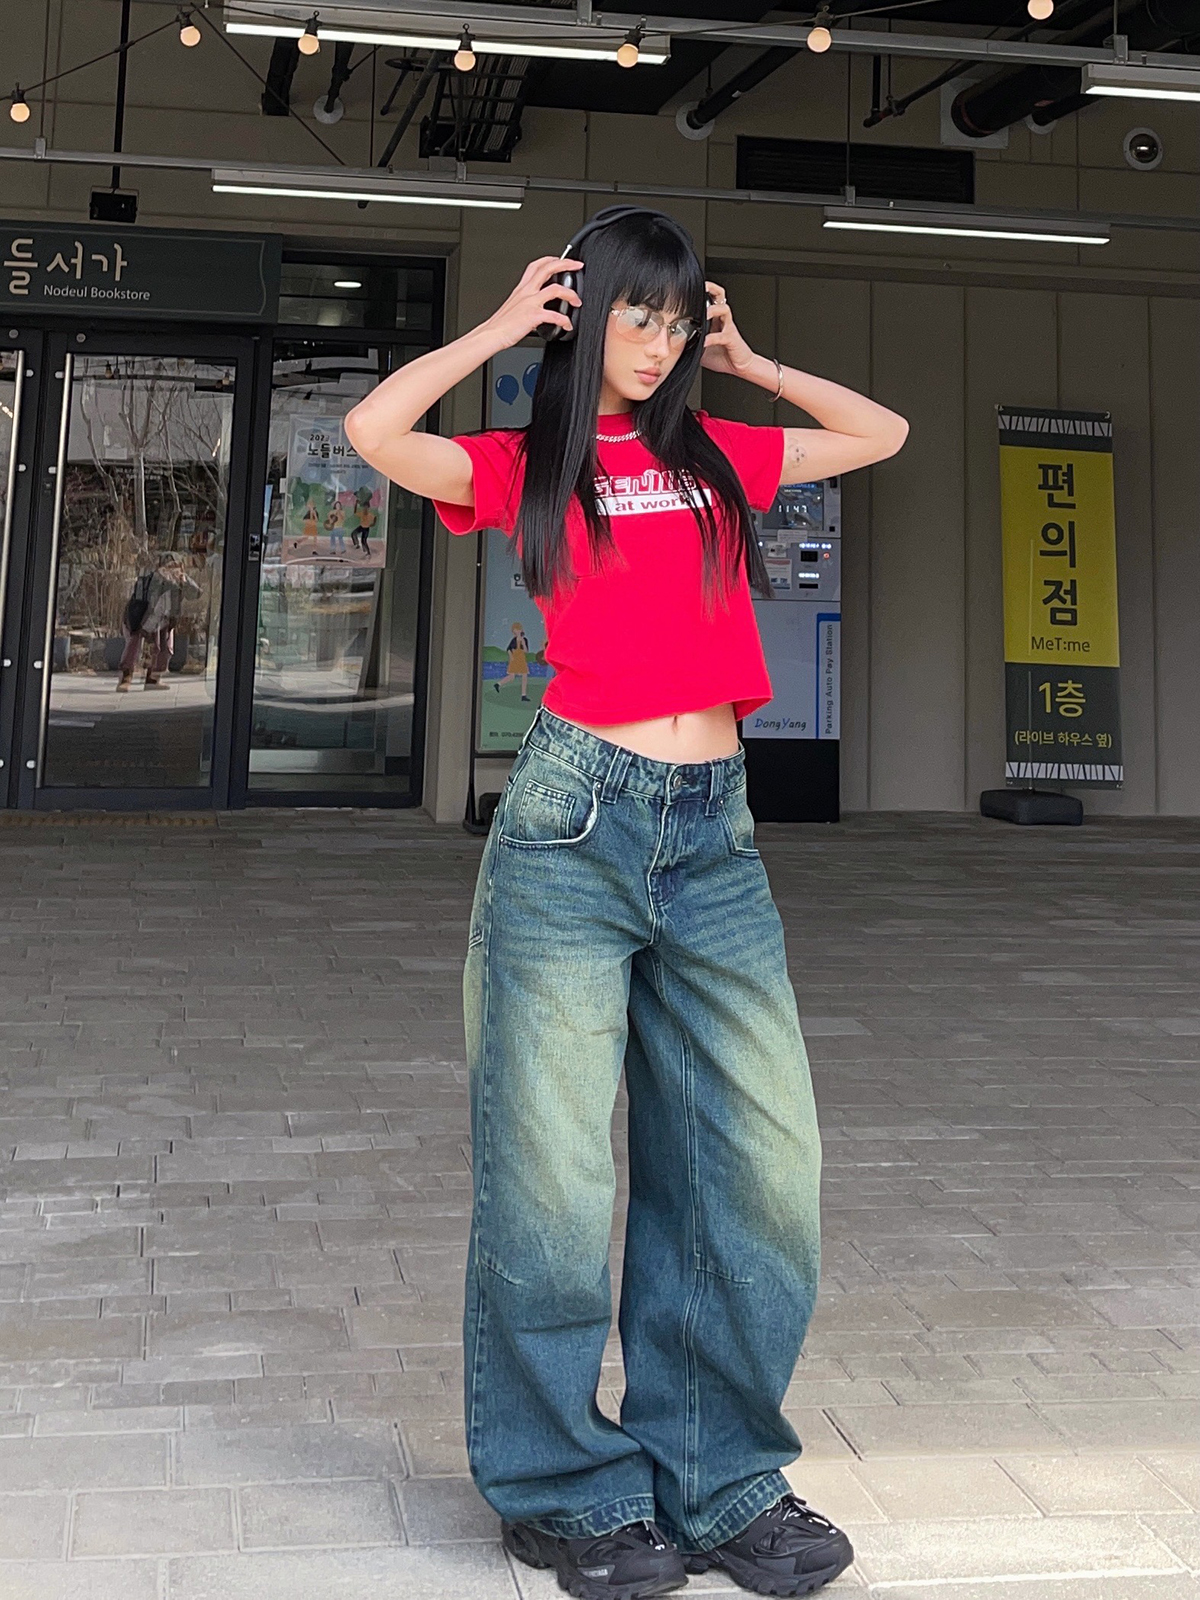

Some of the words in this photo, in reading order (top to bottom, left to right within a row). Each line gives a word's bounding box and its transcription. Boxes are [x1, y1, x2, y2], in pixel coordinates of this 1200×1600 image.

[4, 238, 128, 295] 들서가
[44, 285, 88, 298] Nodeul
[91, 287, 150, 301] Bookstore
[615, 500, 635, 512] at
[1037, 463, 1078, 626] 편의점
[825, 624, 833, 656] Station
[1031, 636, 1091, 652] MeT:me
[825, 658, 834, 674] Pay
[825, 676, 833, 697] Auto
[1039, 680, 1086, 718] 1층
[754, 718, 807, 731] DongYang
[825, 700, 834, 734] Parking
[1014, 730, 1055, 745] (라이브
[1057, 732, 1093, 746] 하우스
[1096, 733, 1112, 749] 옆)
